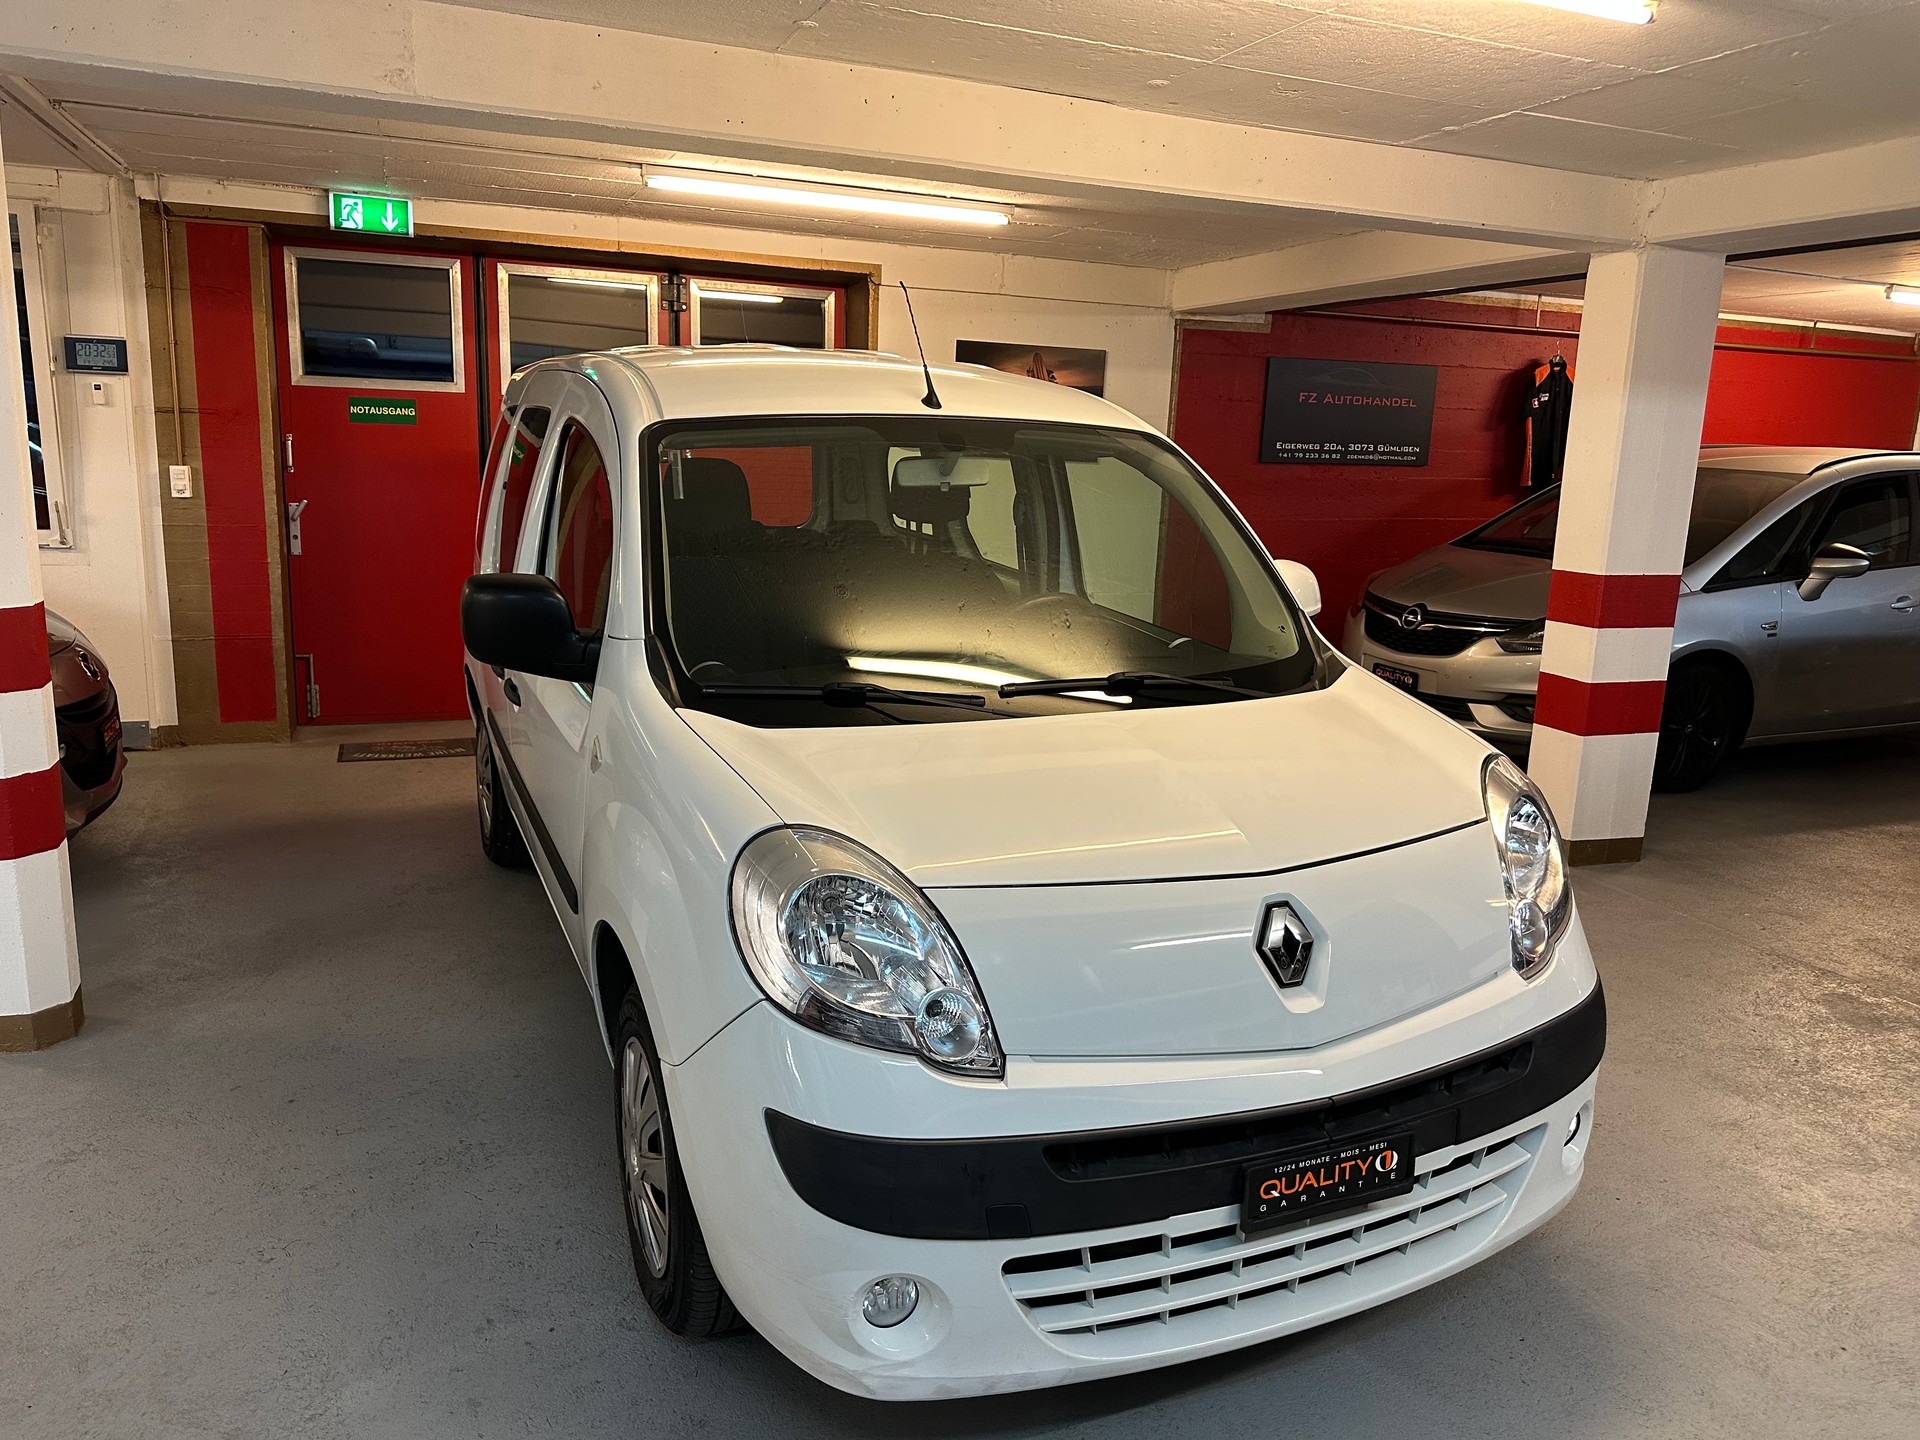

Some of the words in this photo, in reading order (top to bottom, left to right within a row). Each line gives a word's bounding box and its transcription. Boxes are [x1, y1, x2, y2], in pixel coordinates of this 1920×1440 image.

[1299, 392, 1317, 403] FZ
[350, 405, 416, 416] NOTAUSGANG
[1348, 443, 1374, 451] 3073
[1375, 668, 1405, 681] QUALITY
[1274, 1163, 1297, 1174] 12/24
[1298, 1155, 1331, 1168] MONATE
[1340, 1148, 1360, 1159] MOIS
[1369, 1142, 1388, 1152] MESI
[1259, 1155, 1374, 1200] QUALITY
[1259, 1172, 1397, 1212] GARANTIE
